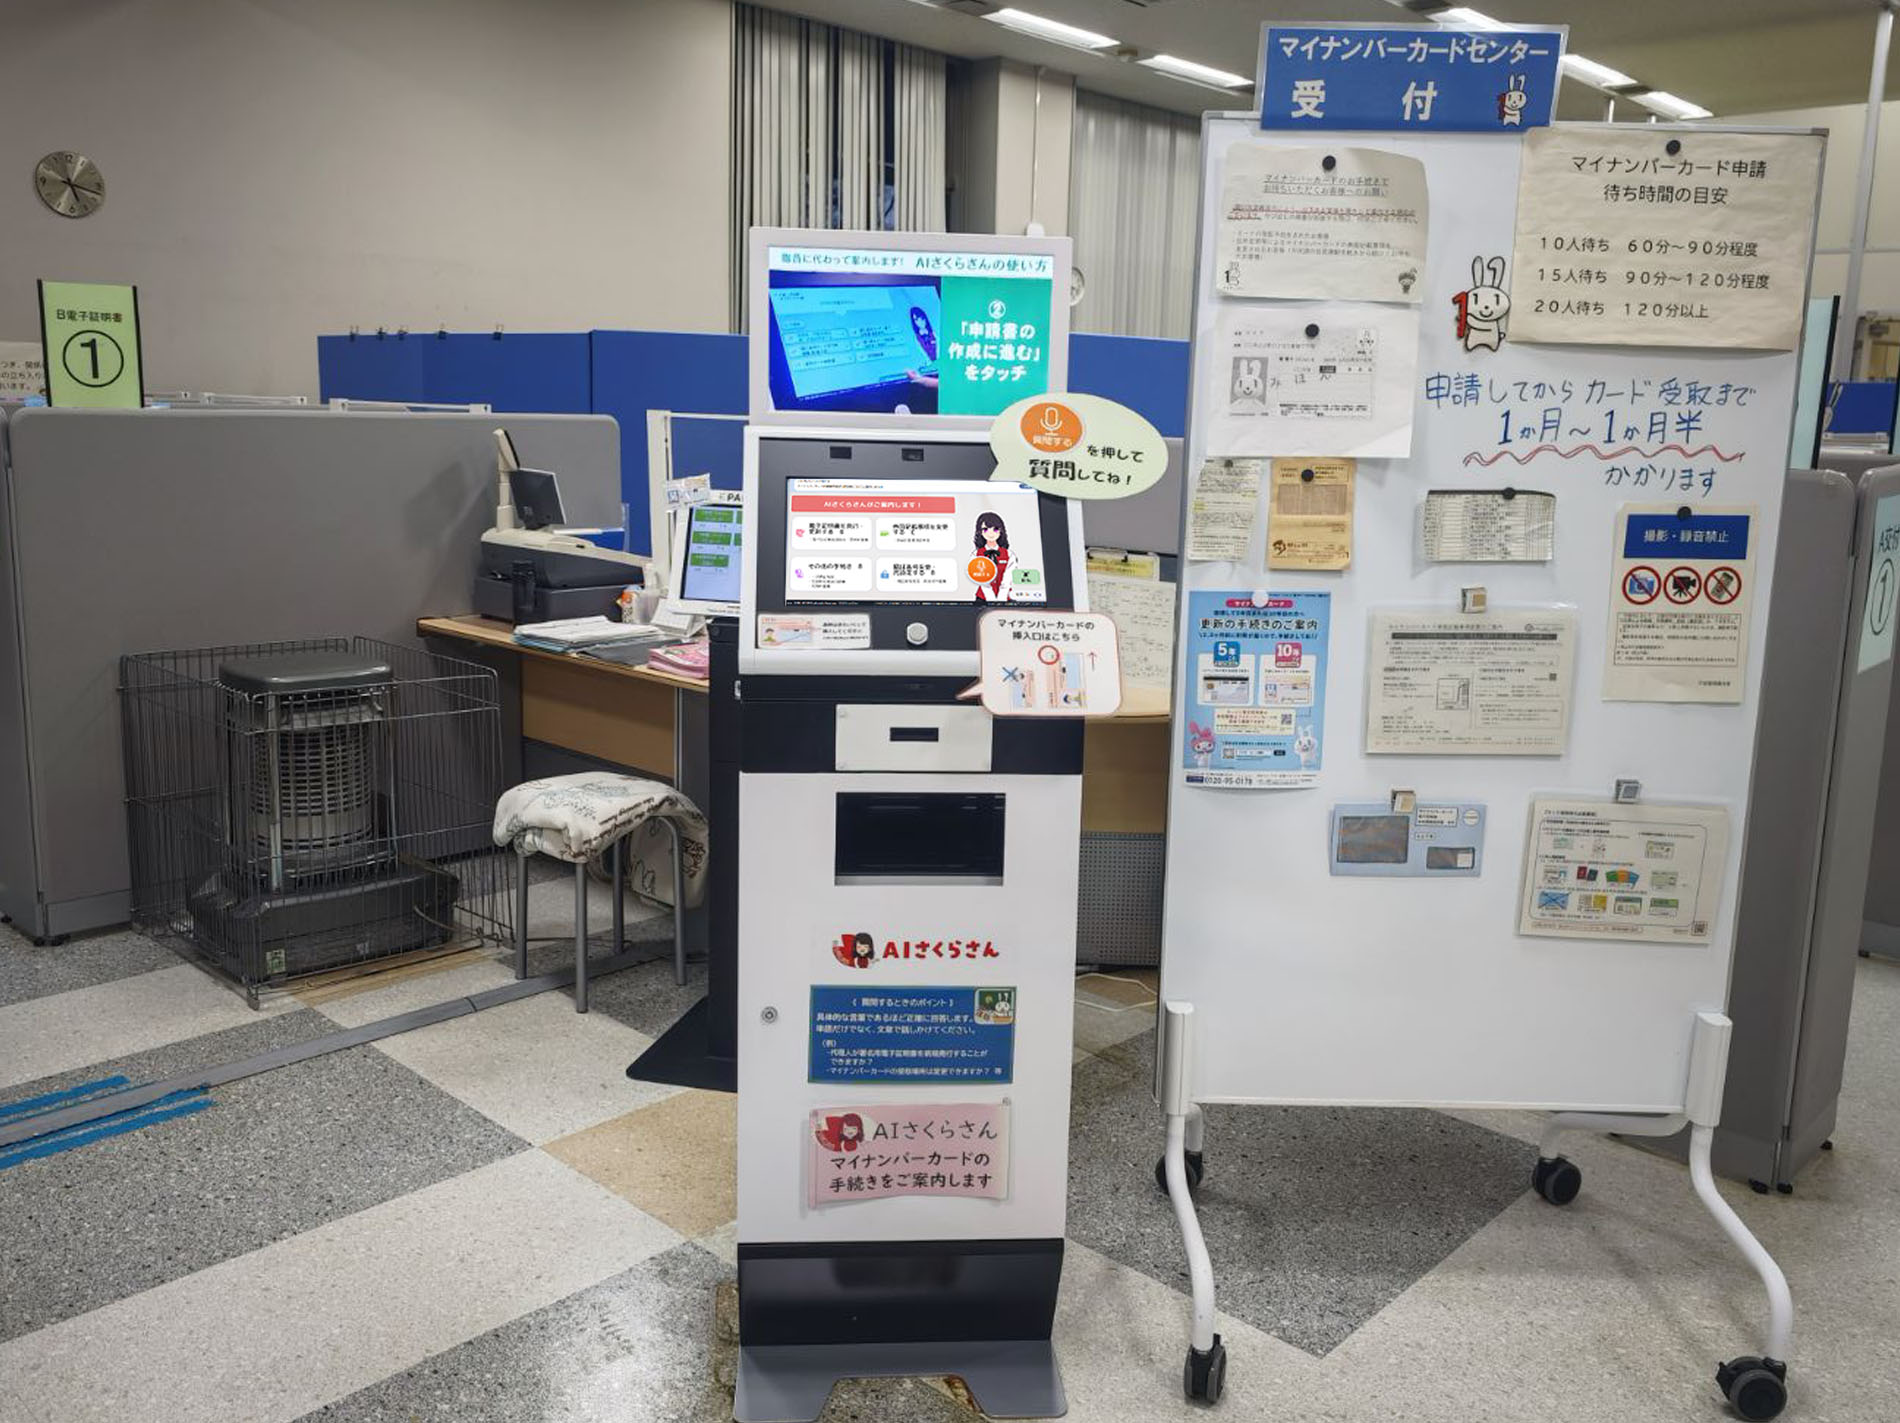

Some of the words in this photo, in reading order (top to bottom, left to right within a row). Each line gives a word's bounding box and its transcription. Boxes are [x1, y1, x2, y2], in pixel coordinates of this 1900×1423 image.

[1279, 36, 1549, 64] マイナンバーカードセンター
[1291, 79, 1438, 121] 受付
[1571, 156, 1767, 179] マイナンバーカード申請
[1604, 184, 1729, 205] 待ち時間の目安
[1541, 237, 1610, 252] 10人待ち
[1628, 240, 1758, 257] 60分～90分程度
[915, 258, 1047, 272] AIさくらさんの使い方
[1539, 269, 1607, 285] 15人待ち
[1625, 272, 1770, 290] 90分～120分程度
[56, 309, 123, 323] B電子証明書
[1534, 299, 1605, 316] 20人待ち
[1624, 303, 1709, 319] 120分以上
[948, 342, 1040, 362] 作成に進む」
[965, 364, 1027, 381] をタッチ
[1087, 445, 1144, 463] を押して
[1028, 459, 1132, 485] 質問してね！
[1604, 464, 1717, 498] かかります
[727, 493, 743, 502] PA
[1643, 530, 1729, 543] 撮影・録音禁止
[998, 619, 1095, 630] マイナンバーカードの
[1200, 619, 1318, 630] 更新の手続きのご案内
[1012, 631, 1081, 642] 挿入口はこちら
[882, 940, 1000, 959] AIさくらさん
[872, 1120, 998, 1141] AIさくらさん
[830, 1151, 990, 1170] マイナンバーカードの
[829, 1172, 993, 1193] 手続きをご案内します
